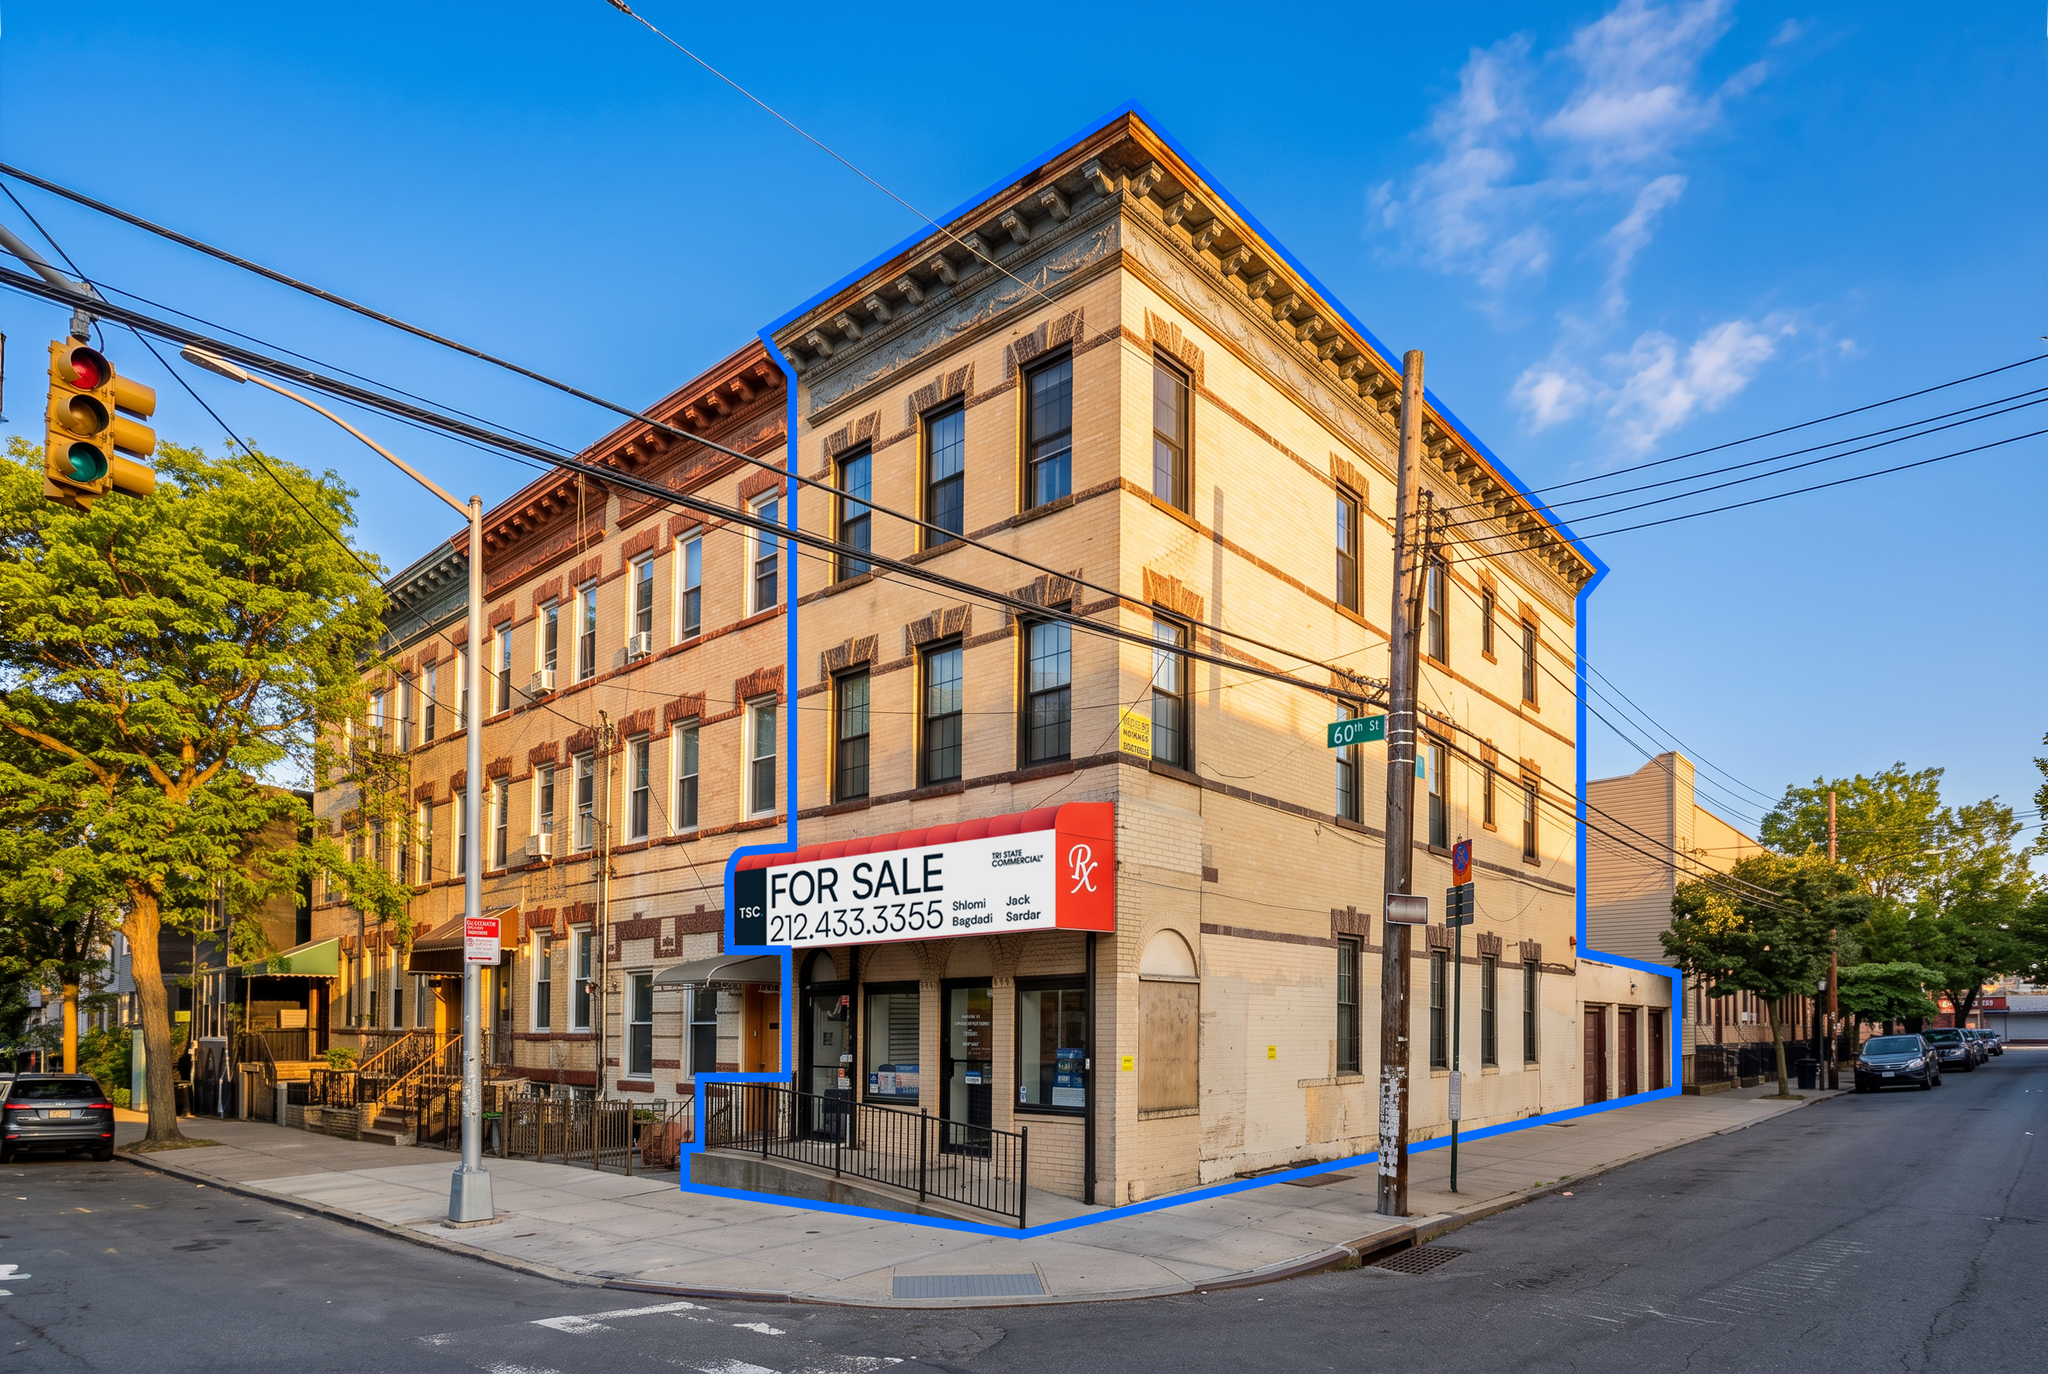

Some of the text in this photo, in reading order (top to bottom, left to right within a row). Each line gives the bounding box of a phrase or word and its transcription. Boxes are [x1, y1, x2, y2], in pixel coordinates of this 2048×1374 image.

[1334, 720, 1379, 744] 60th St
[992, 849, 1022, 860] TRI STATE
[771, 853, 944, 909] FOR SALE
[952, 898, 986, 911] Shlomi
[1006, 894, 1030, 907] Jack
[770, 899, 944, 943] 212.433.3355
[952, 913, 993, 928] Bagdadi
[1006, 910, 1041, 922] Sardar
